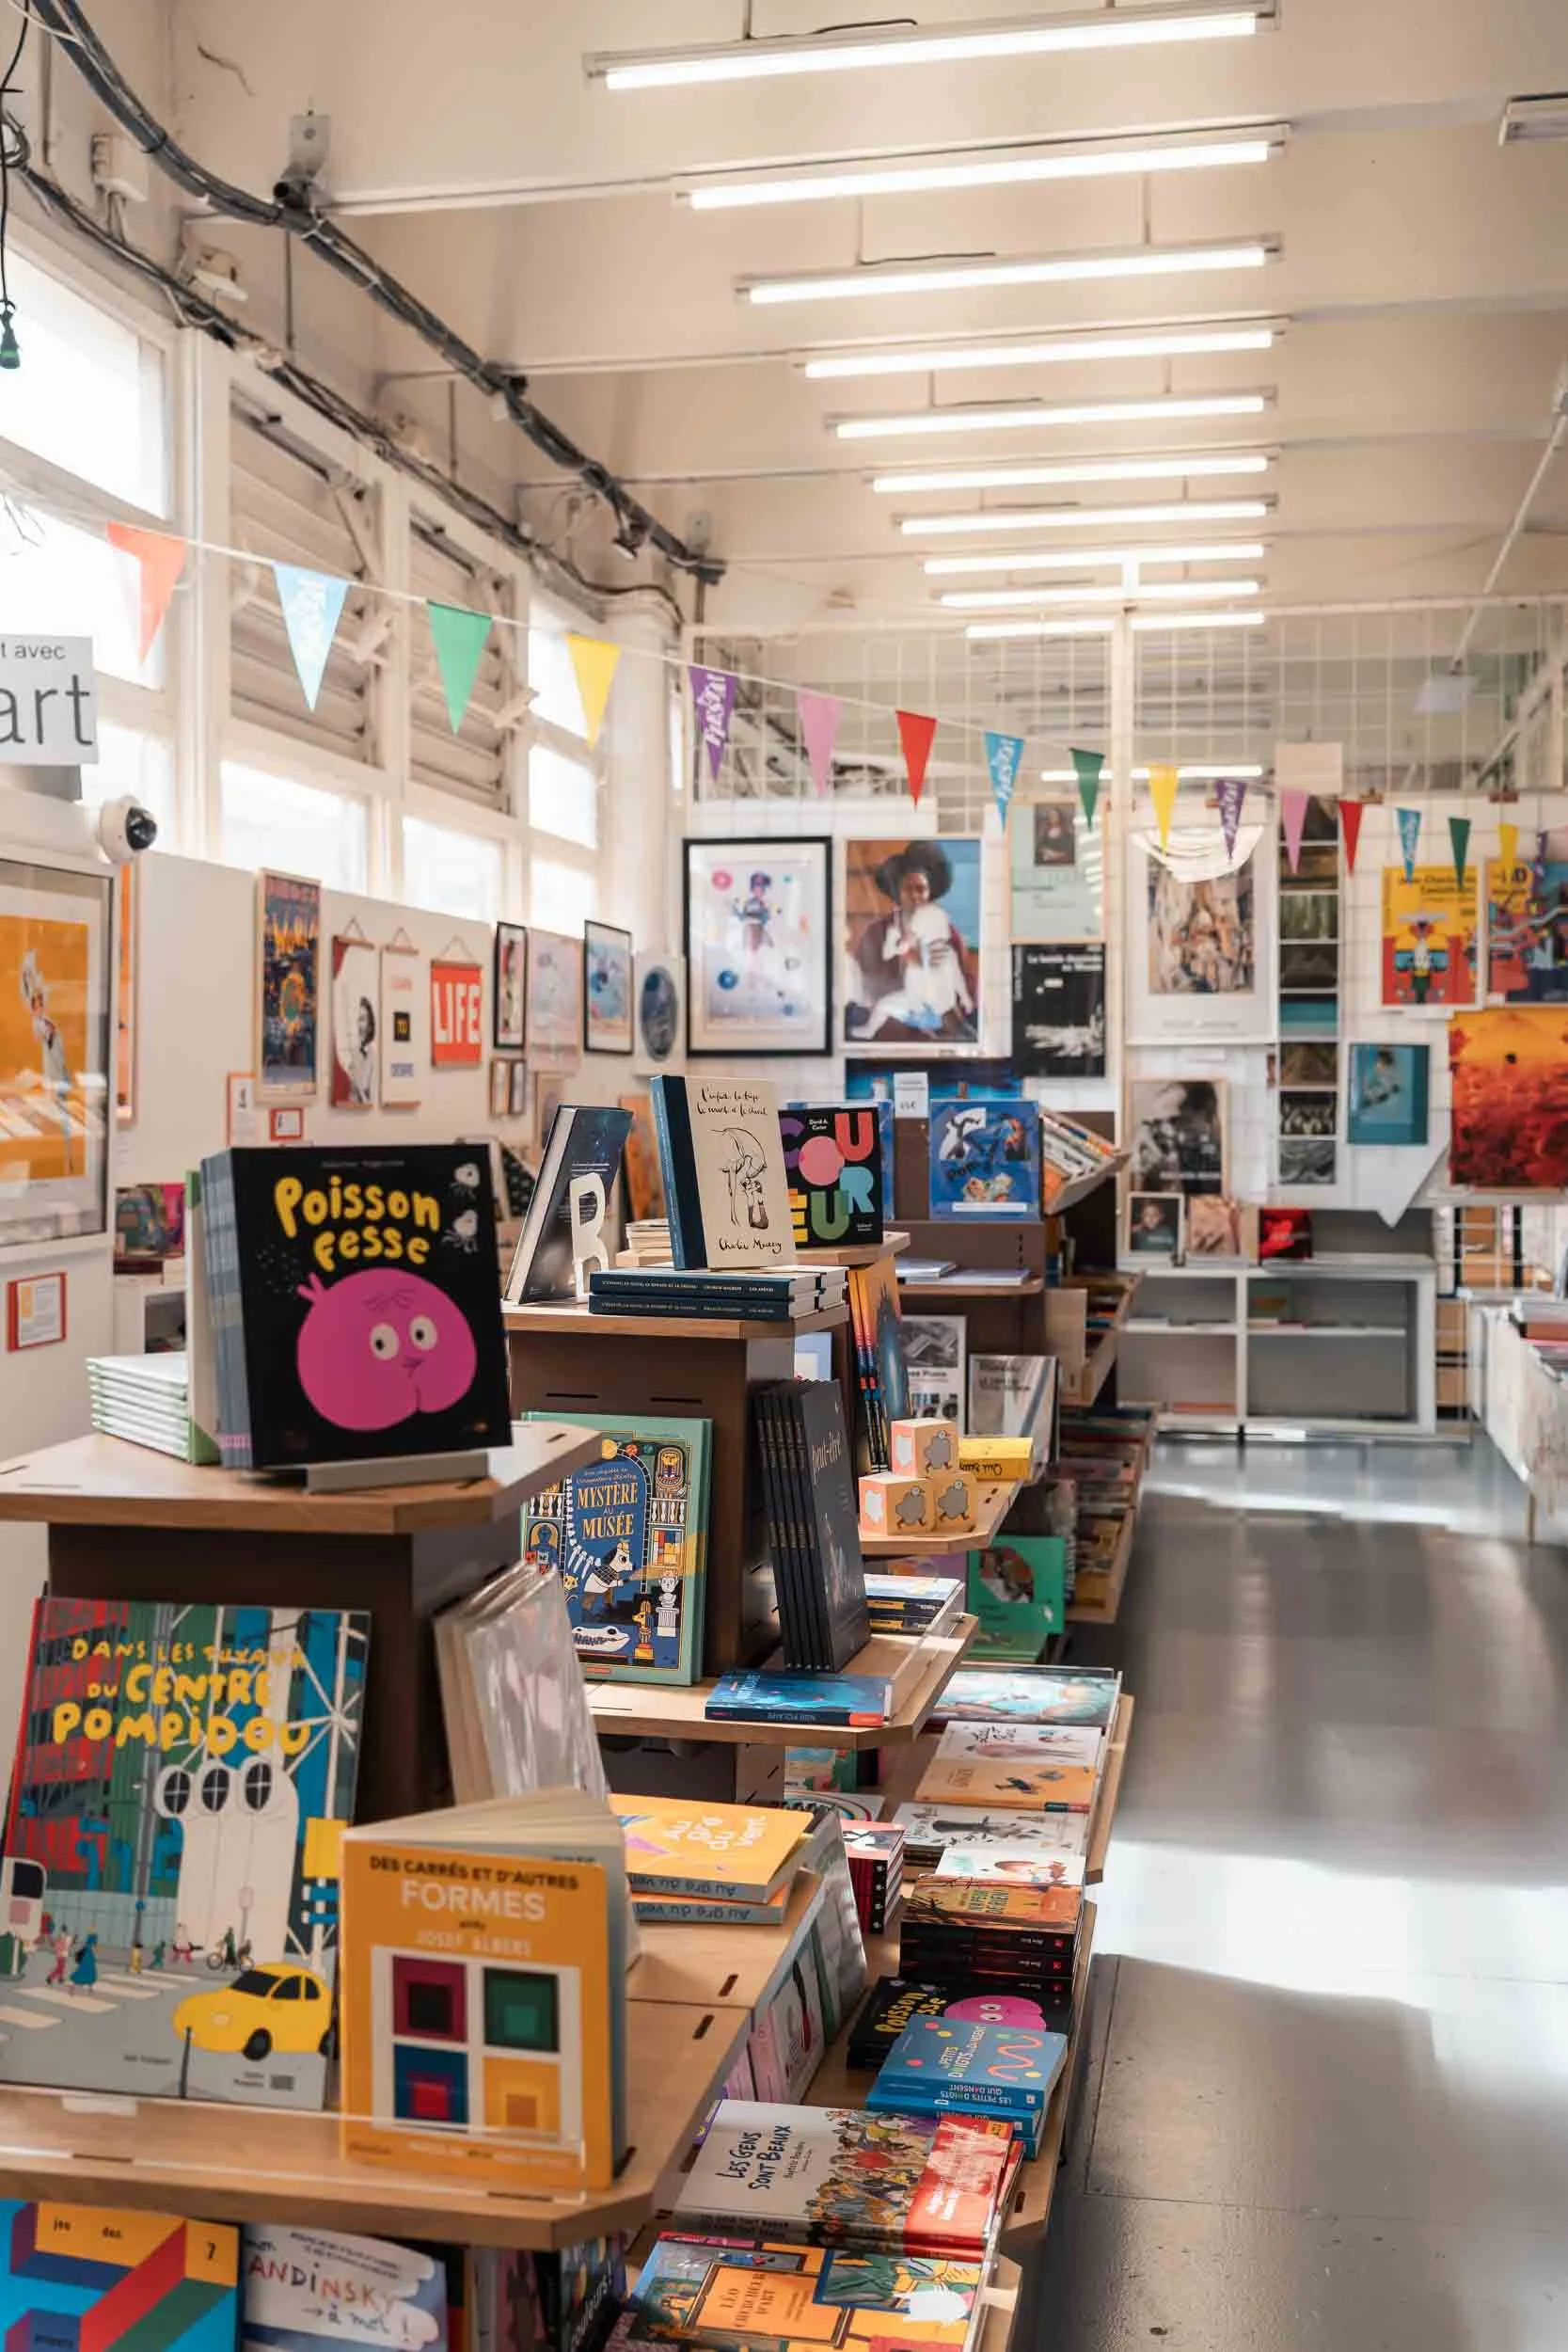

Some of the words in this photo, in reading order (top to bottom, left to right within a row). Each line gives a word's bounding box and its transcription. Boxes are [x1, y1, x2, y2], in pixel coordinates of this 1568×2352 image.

[15, 644, 66, 660] avec
[432, 980, 481, 1044] LIFE
[274, 1175, 440, 1239] Poisson
[312, 1225, 430, 1272] fesse
[578, 1482, 638, 1508] MYSTÈRE
[582, 1510, 634, 1539] MUSÉE
[71, 1637, 146, 1661] DANS
[157, 1642, 195, 1662] LES
[87, 1682, 118, 1698] DU
[125, 1663, 272, 1707] CENTRE
[370, 1856, 401, 1872] DES
[404, 1861, 469, 1882] CARRÉS
[468, 1867, 492, 1882] ET
[497, 1868, 580, 1891] D'AUTRES
[401, 1879, 546, 1921] FORMES
[715, 1885, 738, 1898] Au
[670, 1902, 692, 1917] du
[698, 1904, 724, 1919] gré
[728, 1908, 751, 1920] Au
[875, 1992, 927, 2033] Poisson
[917, 1996, 947, 2016] sse
